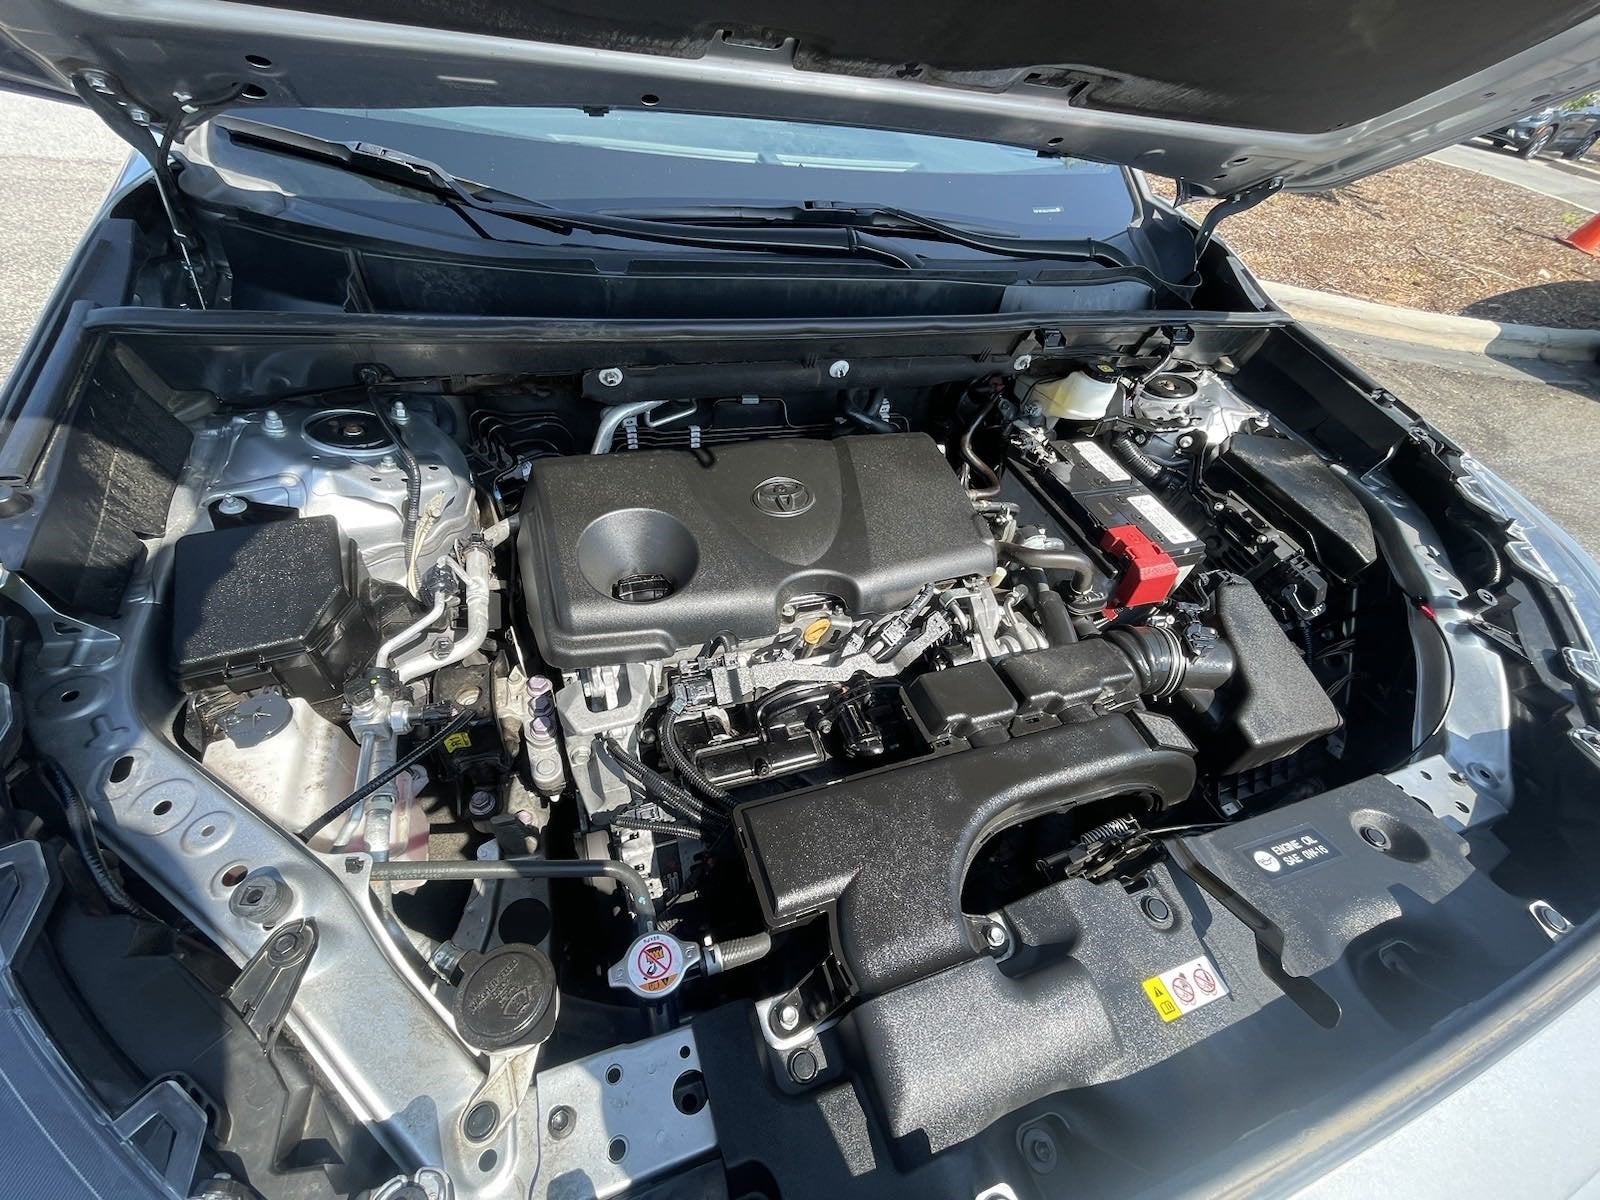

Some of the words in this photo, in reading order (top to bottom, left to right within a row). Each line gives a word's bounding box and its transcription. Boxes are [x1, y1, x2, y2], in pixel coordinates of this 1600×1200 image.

[1271, 840, 1303, 855] ENGINE
[1300, 835, 1318, 846] OIL
[1282, 853, 1304, 866] SAE
[1301, 845, 1329, 860] 0W-16
[469, 978, 499, 1013] WASHER
